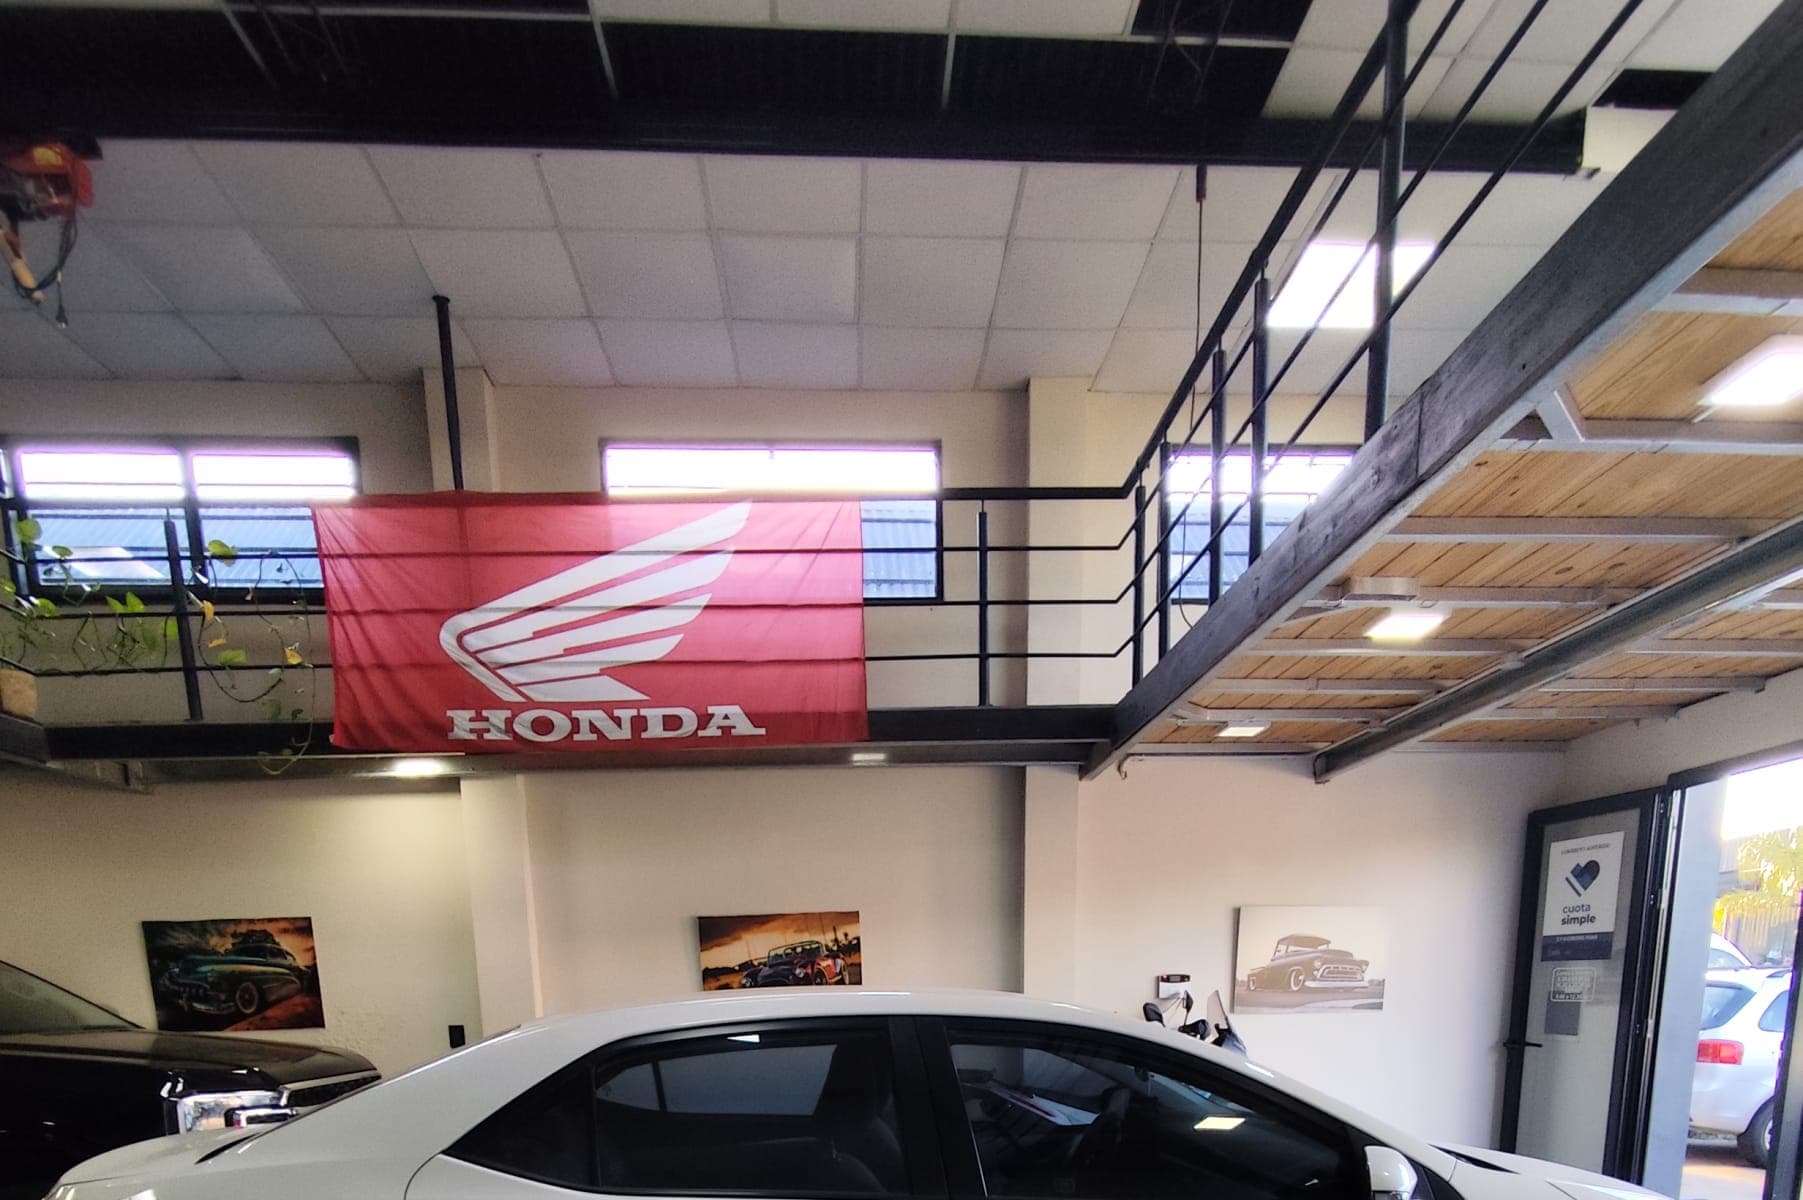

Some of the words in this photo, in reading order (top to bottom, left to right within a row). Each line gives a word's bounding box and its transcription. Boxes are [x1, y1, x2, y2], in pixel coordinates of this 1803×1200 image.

[446, 705, 766, 741] HONDA
[1562, 904, 1591, 914] cuota
[1561, 914, 1597, 926] simple
